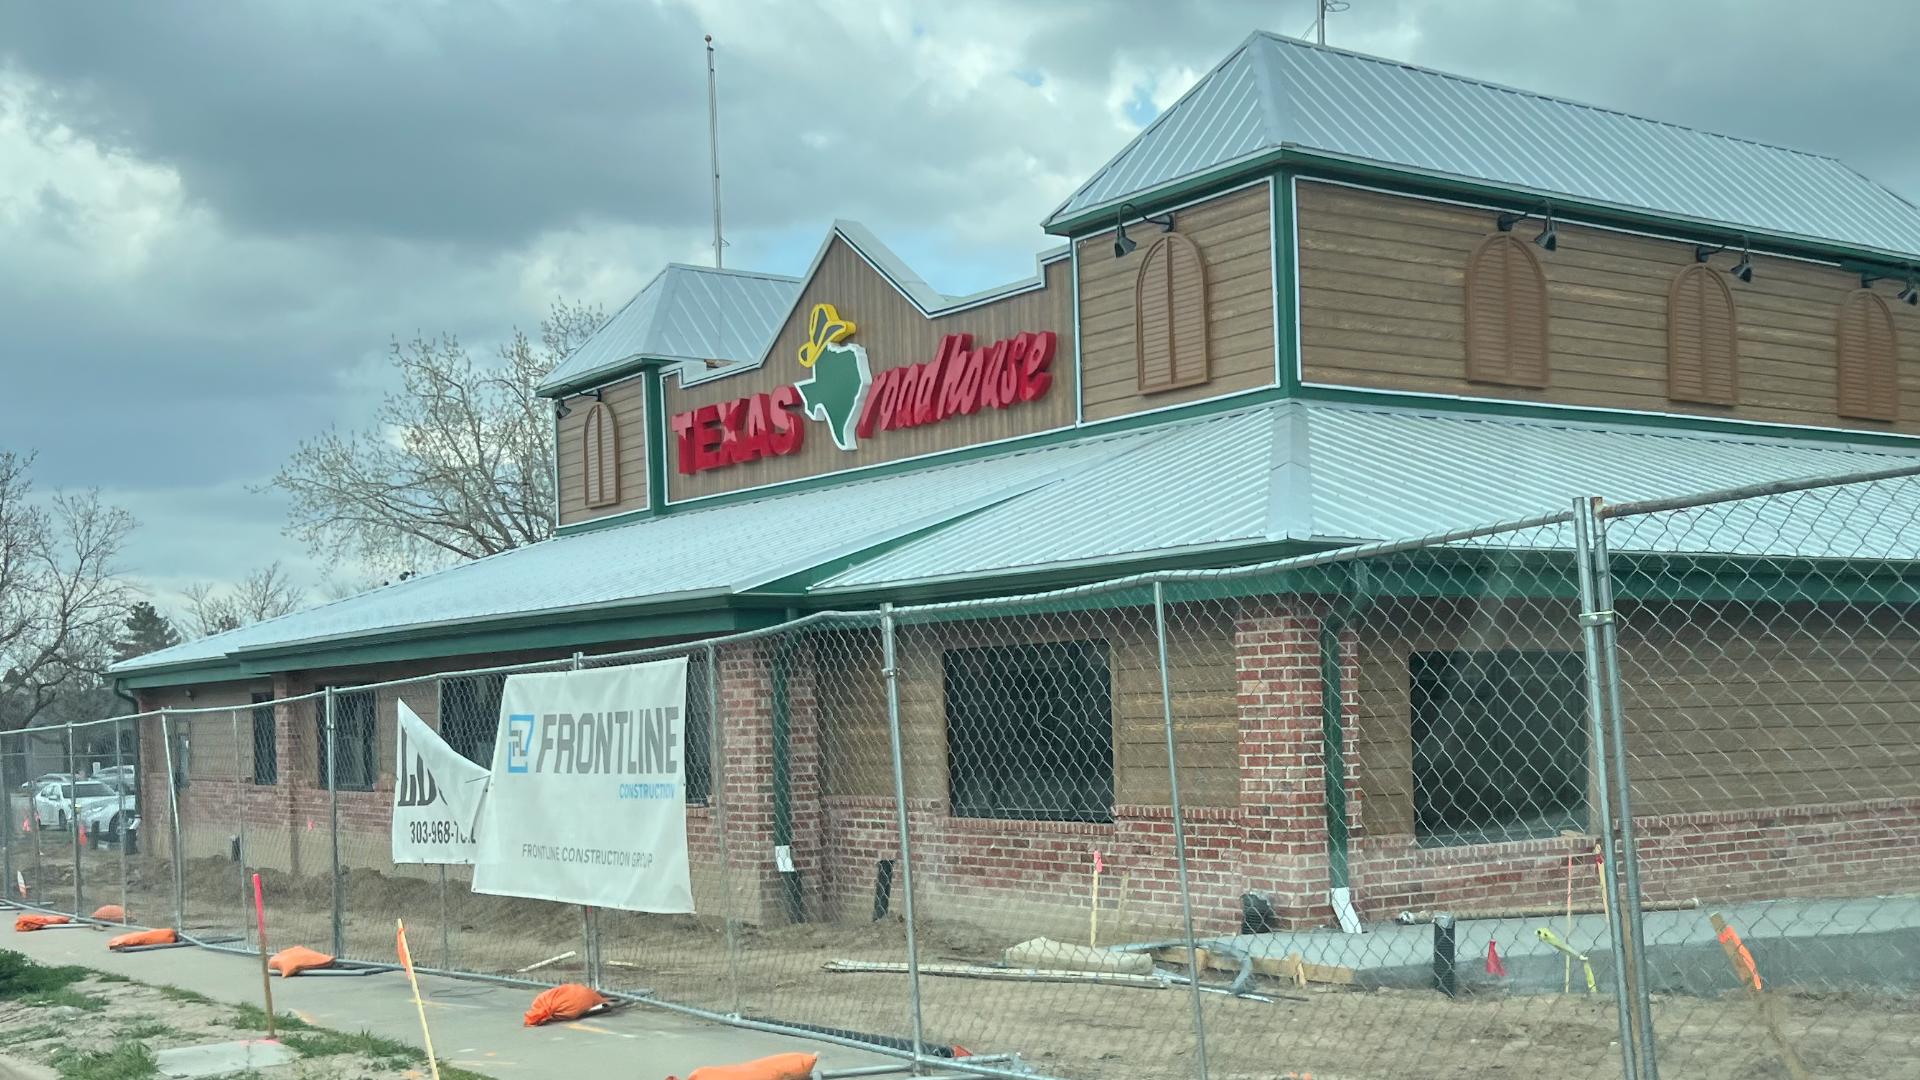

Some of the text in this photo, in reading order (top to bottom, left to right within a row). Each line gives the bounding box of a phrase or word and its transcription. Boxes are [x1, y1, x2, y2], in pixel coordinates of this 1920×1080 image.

[671, 386, 804, 475] TEXAS
[536, 706, 679, 774] FRONTLINE
[619, 783, 675, 799] CONSTRUCTION
[521, 843, 653, 869] FRONTLINE CONSTRUCTION GROUP
